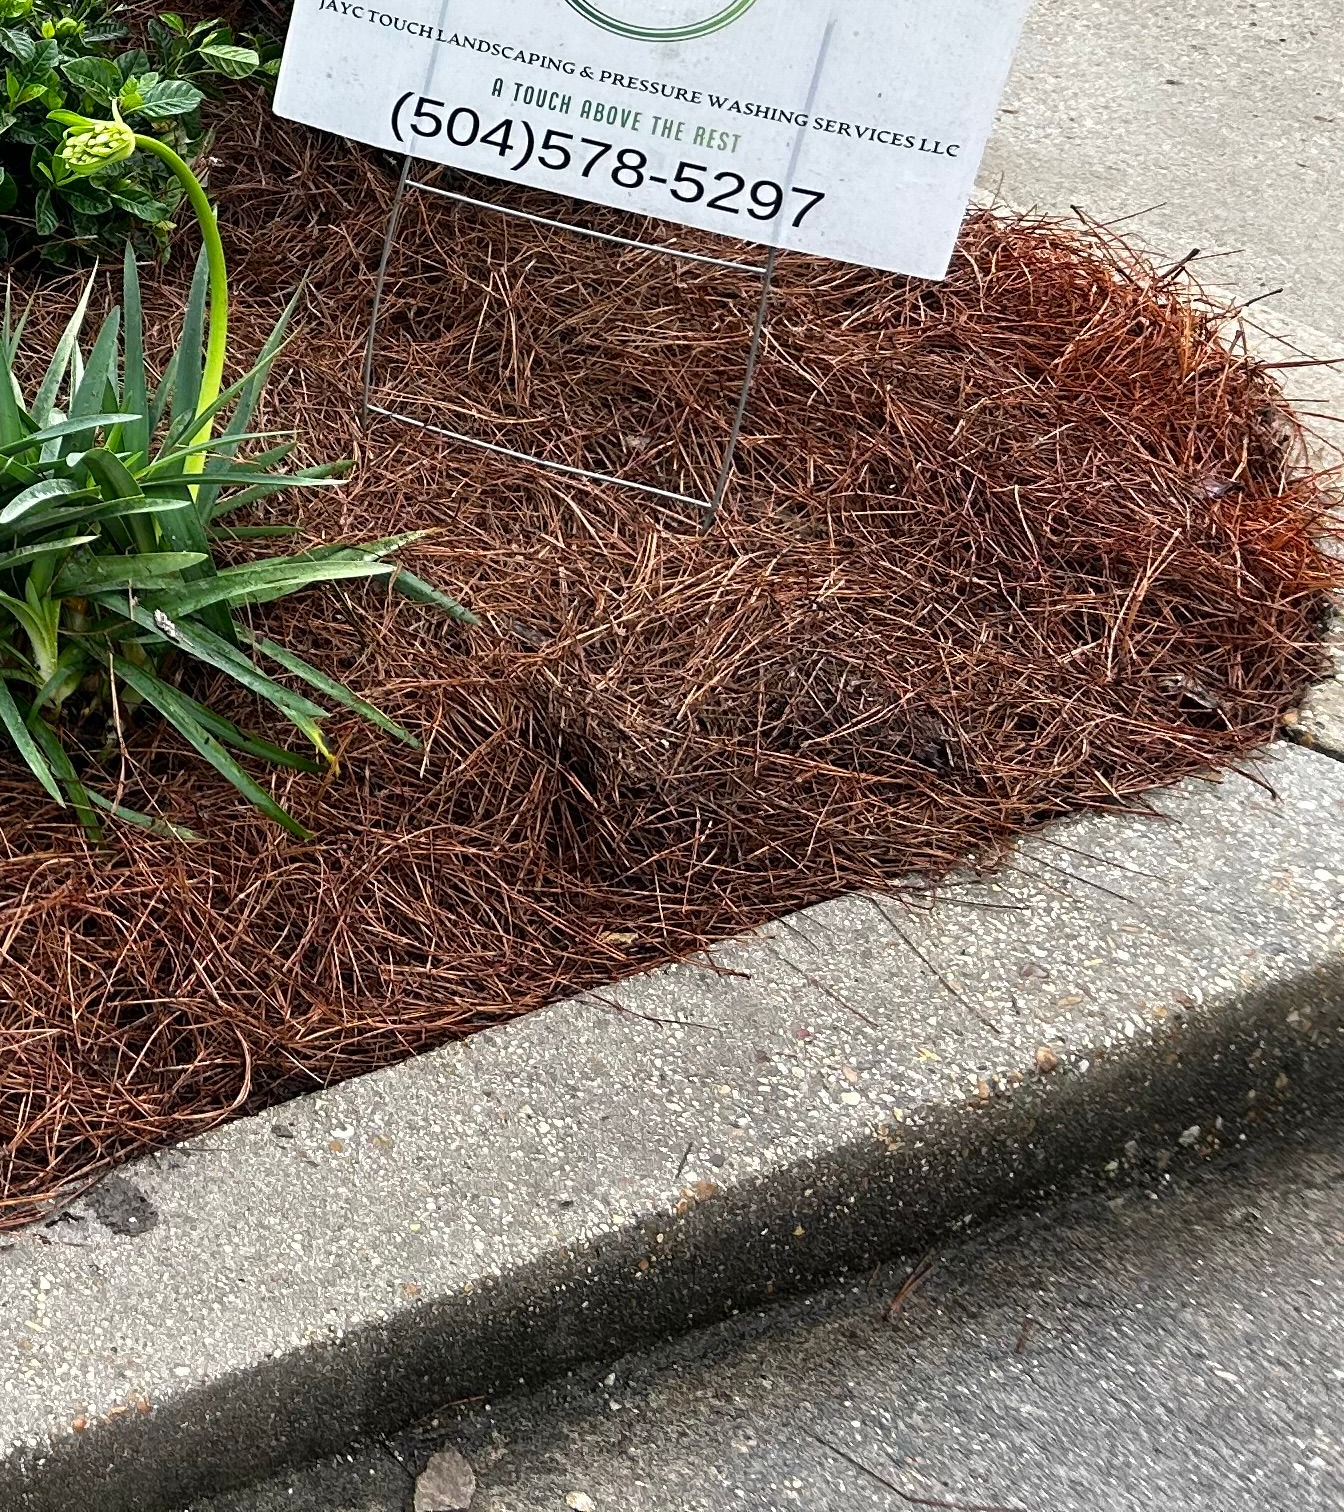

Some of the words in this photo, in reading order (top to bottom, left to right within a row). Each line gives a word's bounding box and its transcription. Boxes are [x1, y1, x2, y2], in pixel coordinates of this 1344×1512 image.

[368, 9, 434, 39] TOUCH
[436, 29, 576, 76] LANDSCAPING
[579, 66, 595, 80] &
[599, 70, 703, 105] PRESSURE
[709, 94, 809, 128] WASHING
[812, 116, 916, 149] SERVICES
[918, 137, 961, 159] LLC
[491, 77, 504, 97] A
[513, 82, 573, 115] TOUCH
[579, 99, 643, 131] ABOVE
[651, 115, 685, 142] THE
[693, 125, 742, 154] REST
[391, 91, 826, 229] (504)578-5297
